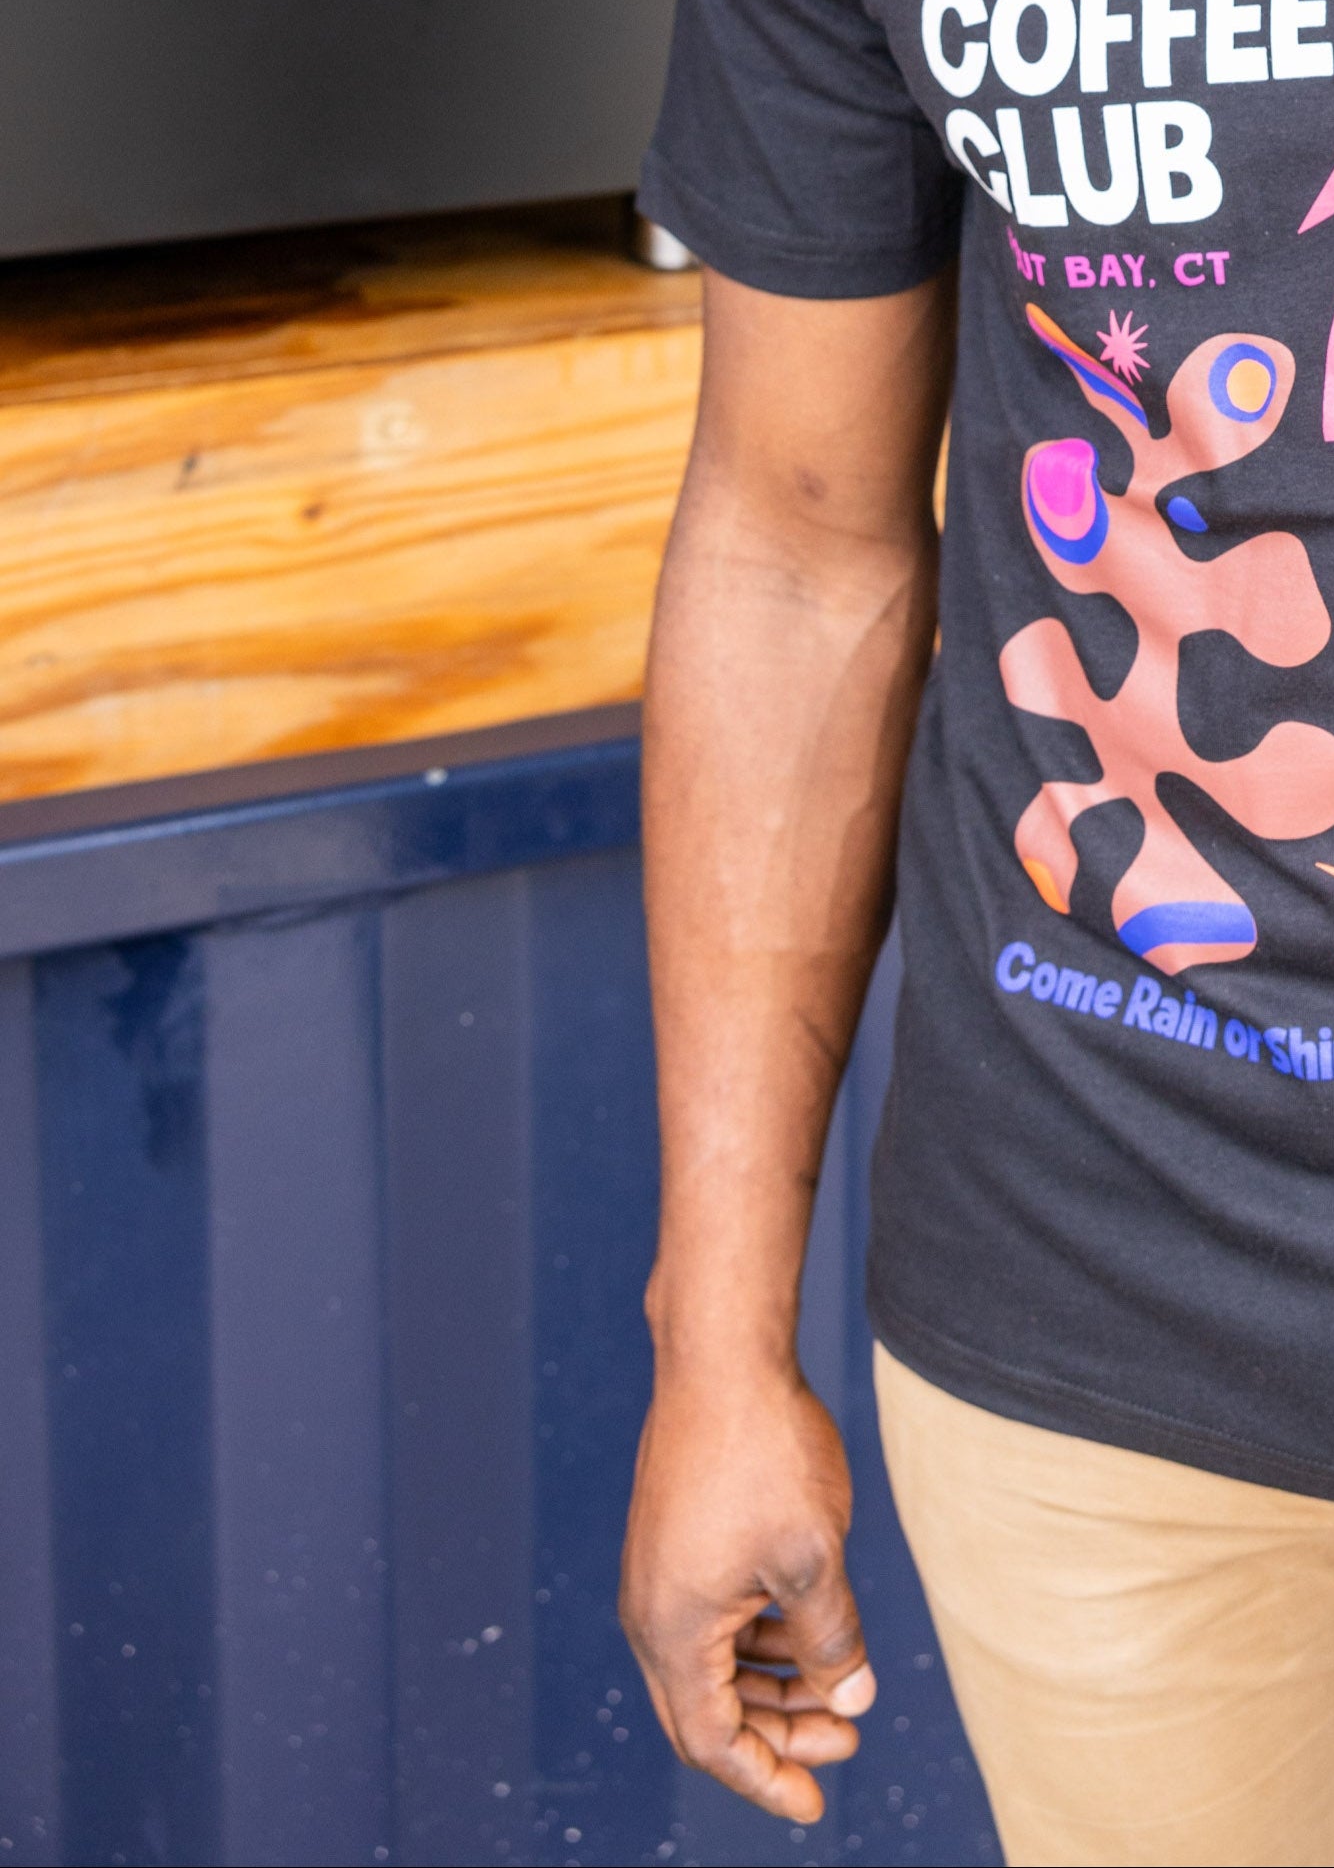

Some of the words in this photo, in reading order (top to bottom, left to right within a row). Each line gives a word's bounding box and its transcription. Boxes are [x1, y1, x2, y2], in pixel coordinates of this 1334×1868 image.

[945, 100, 1224, 227] CLUB
[1006, 225, 1047, 287] UT
[1173, 250, 1231, 286] CT
[995, 941, 1123, 1019] Come
[1123, 974, 1219, 1051] Rain
[1223, 1017, 1264, 1064] or
